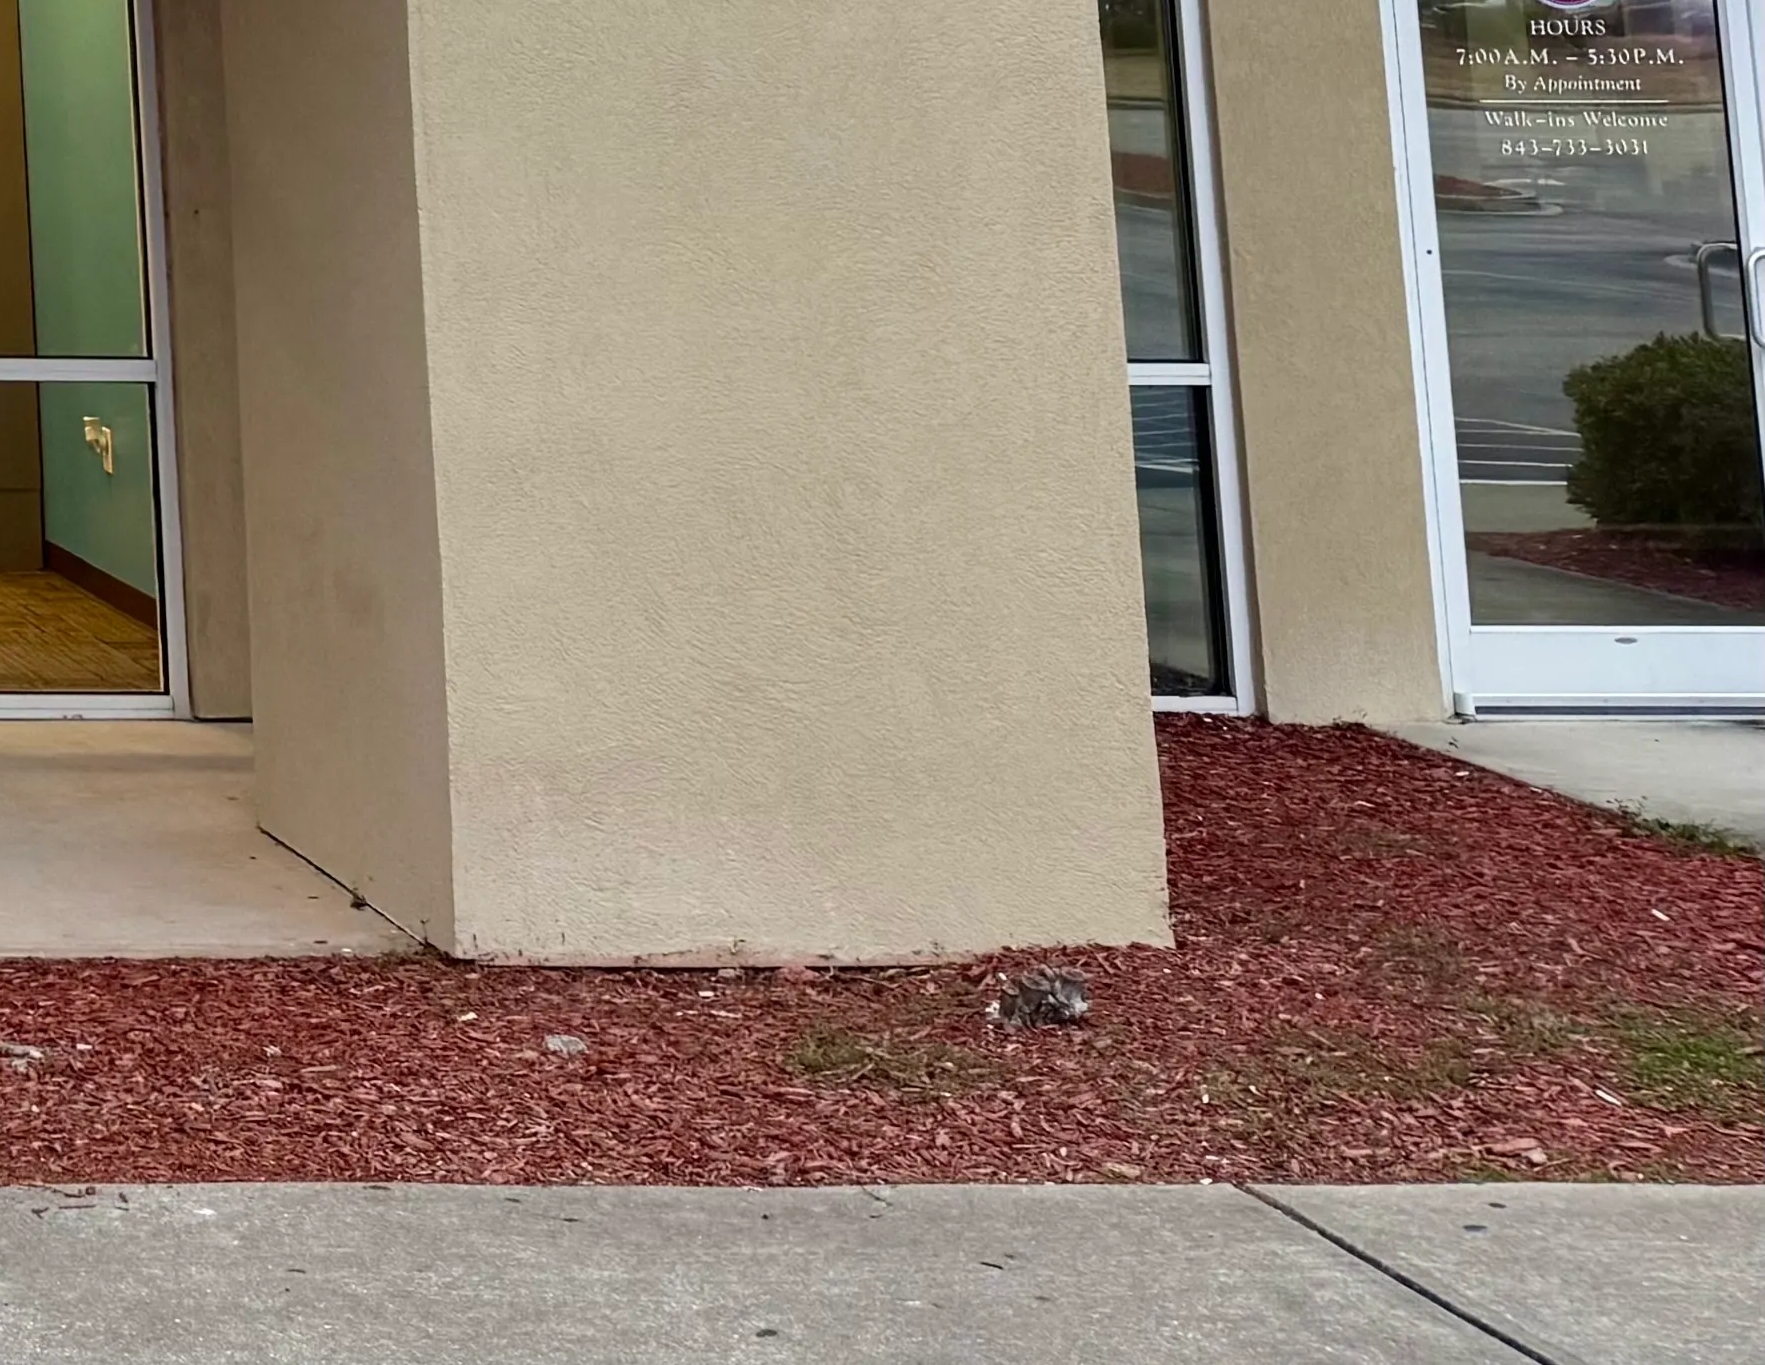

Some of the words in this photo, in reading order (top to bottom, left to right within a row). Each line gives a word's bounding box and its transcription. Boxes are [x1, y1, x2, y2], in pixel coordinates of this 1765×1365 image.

[1530, 19, 1607, 36] HOURS
[1504, 74, 1528, 94] By
[1533, 74, 1642, 95] Appointment
[1583, 110, 1668, 128] Welcome
